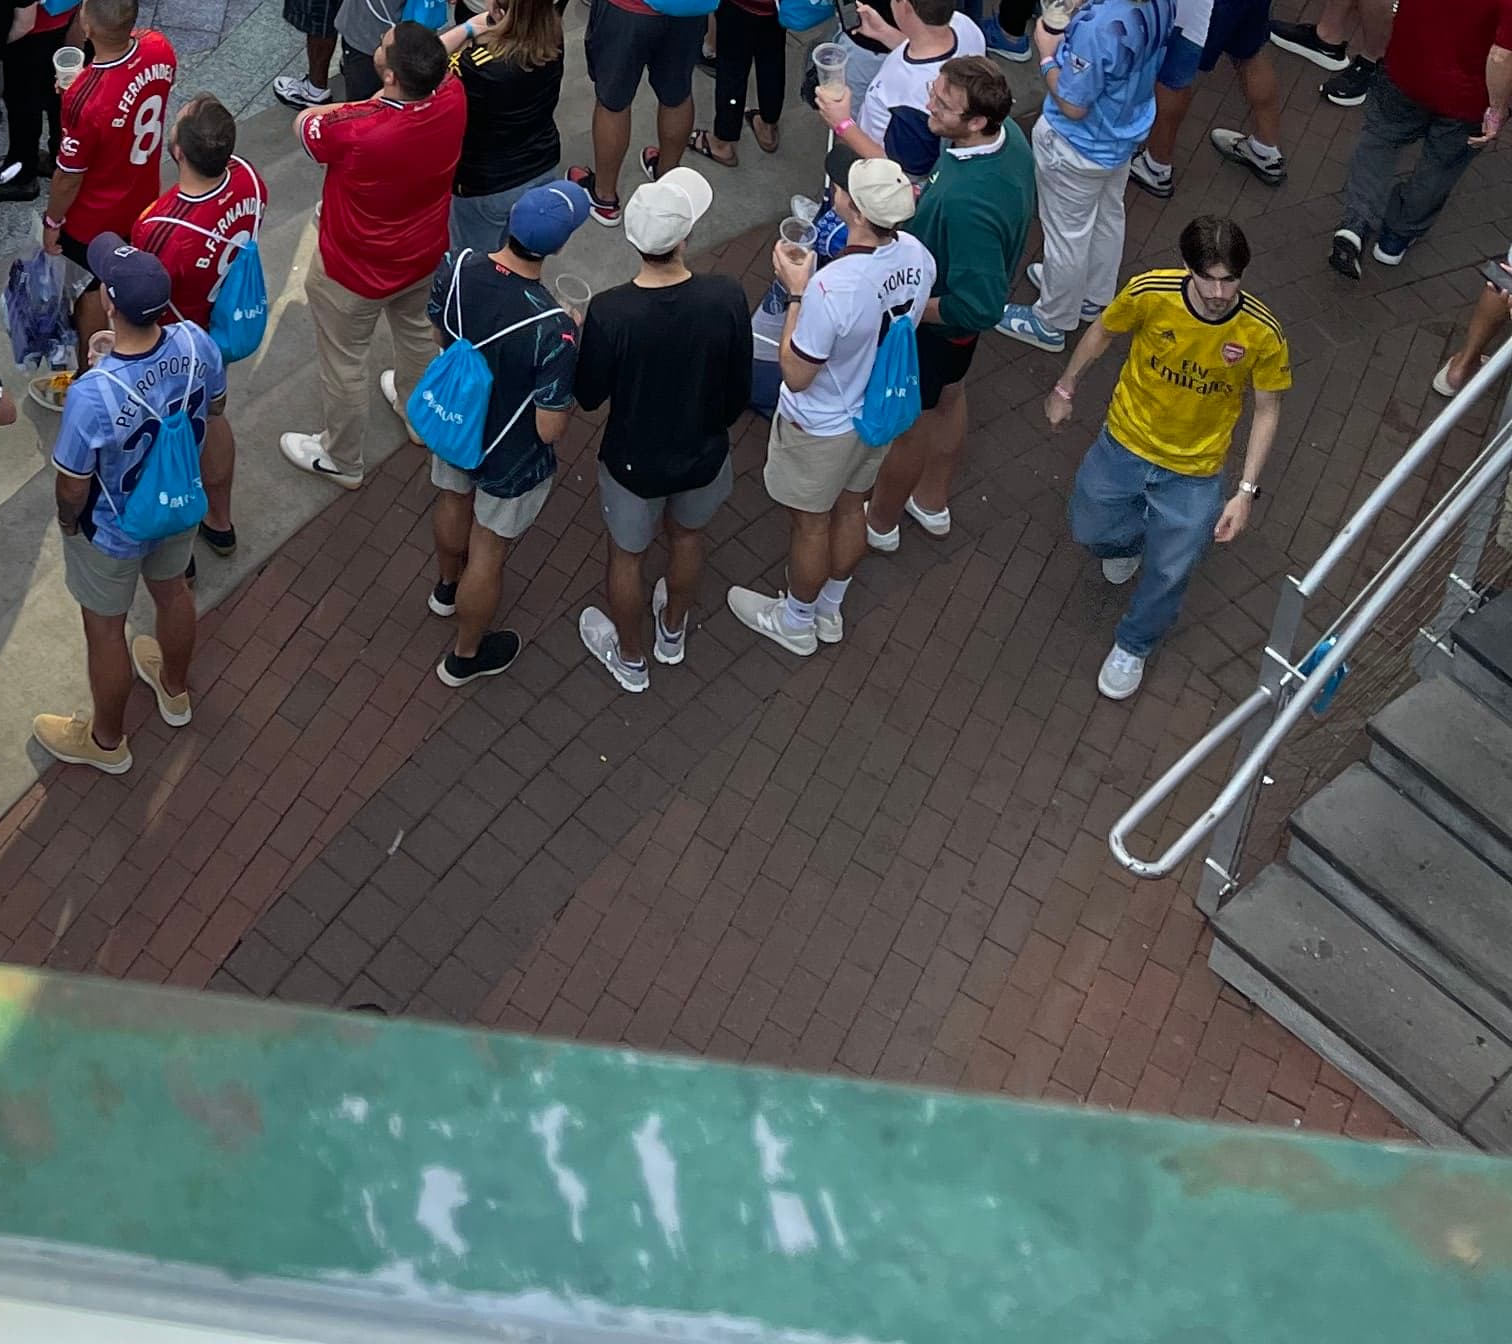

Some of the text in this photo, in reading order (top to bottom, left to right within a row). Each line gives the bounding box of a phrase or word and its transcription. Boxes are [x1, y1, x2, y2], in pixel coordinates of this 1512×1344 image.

[129, 94, 163, 165] 8
[1150, 364, 1233, 397] Emirates
[1181, 359, 1209, 379] Fly
